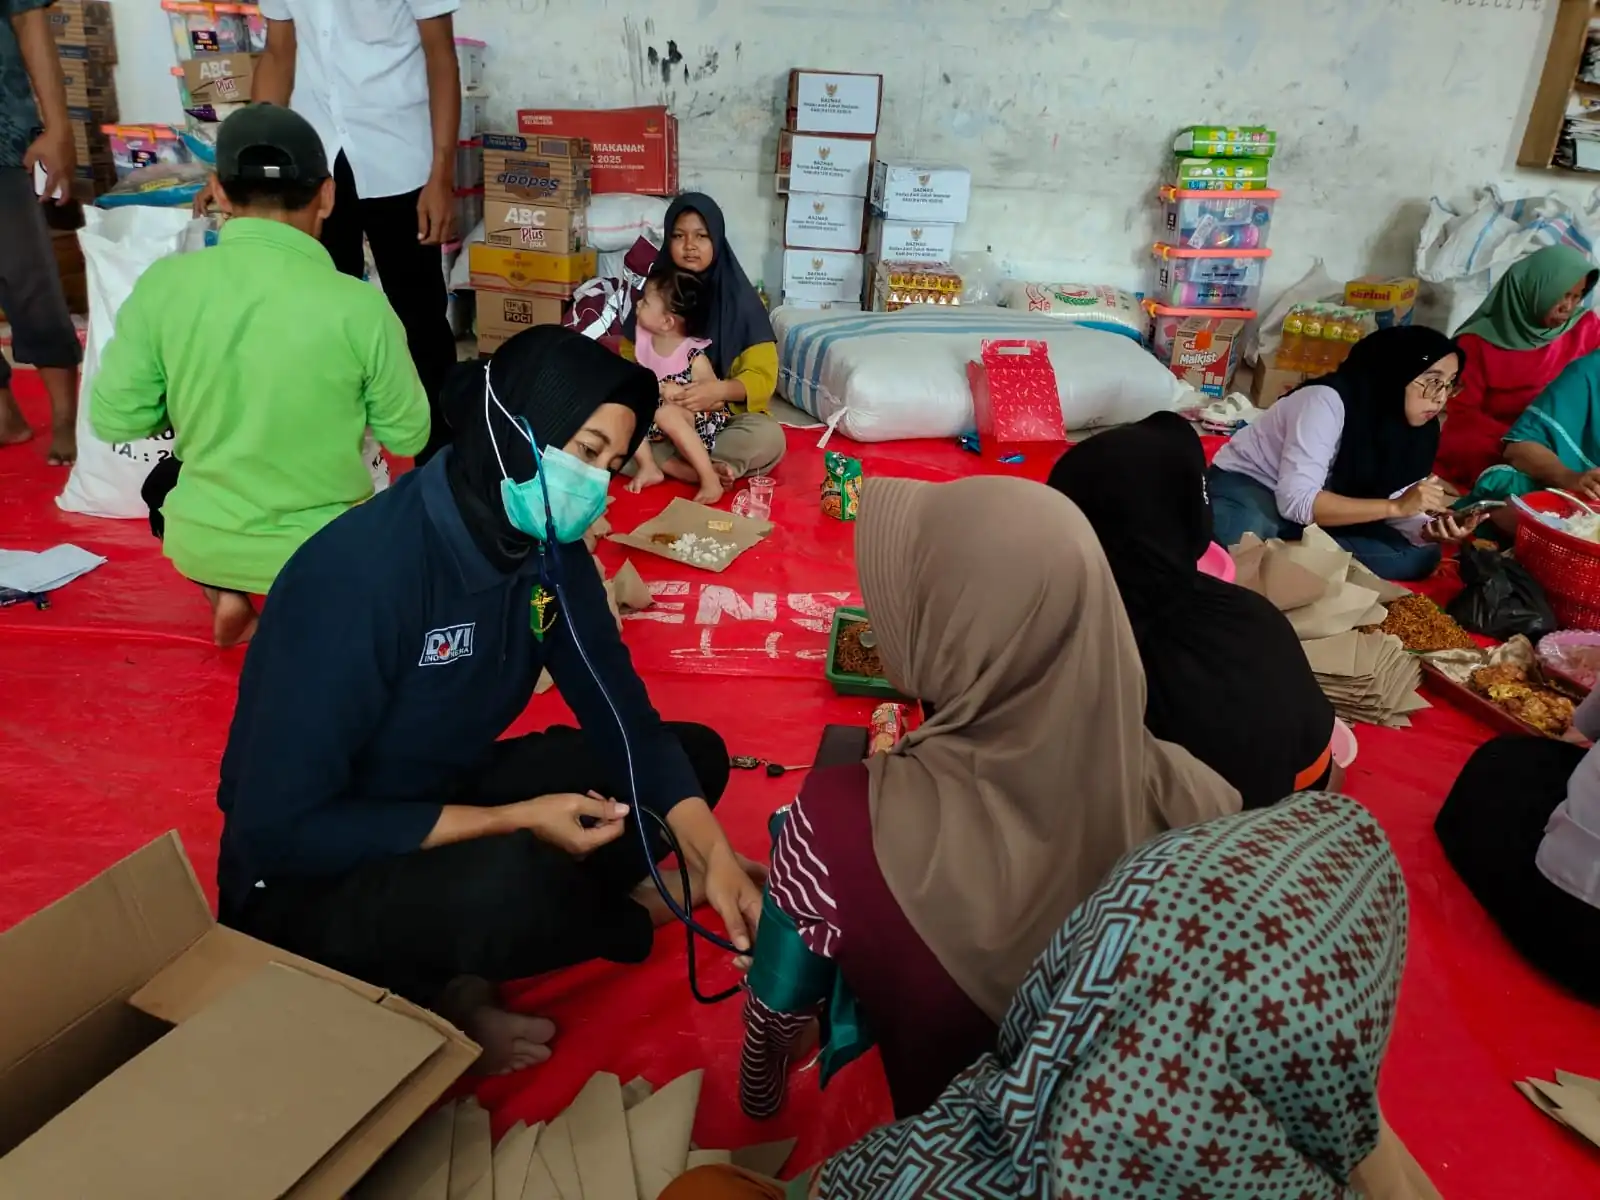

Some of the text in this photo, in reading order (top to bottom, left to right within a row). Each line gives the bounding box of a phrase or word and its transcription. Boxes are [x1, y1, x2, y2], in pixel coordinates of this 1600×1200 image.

[200, 60, 232, 79] ABC
[215, 79, 235, 96] Plus
[593, 143, 645, 153] MAKANAN
[597, 155, 622, 163] 2025
[504, 207, 546, 226] ABC
[521, 228, 544, 242] Plus
[506, 312, 531, 323] POCI
[1179, 351, 1218, 366] Malkist
[425, 627, 471, 656] DVI
